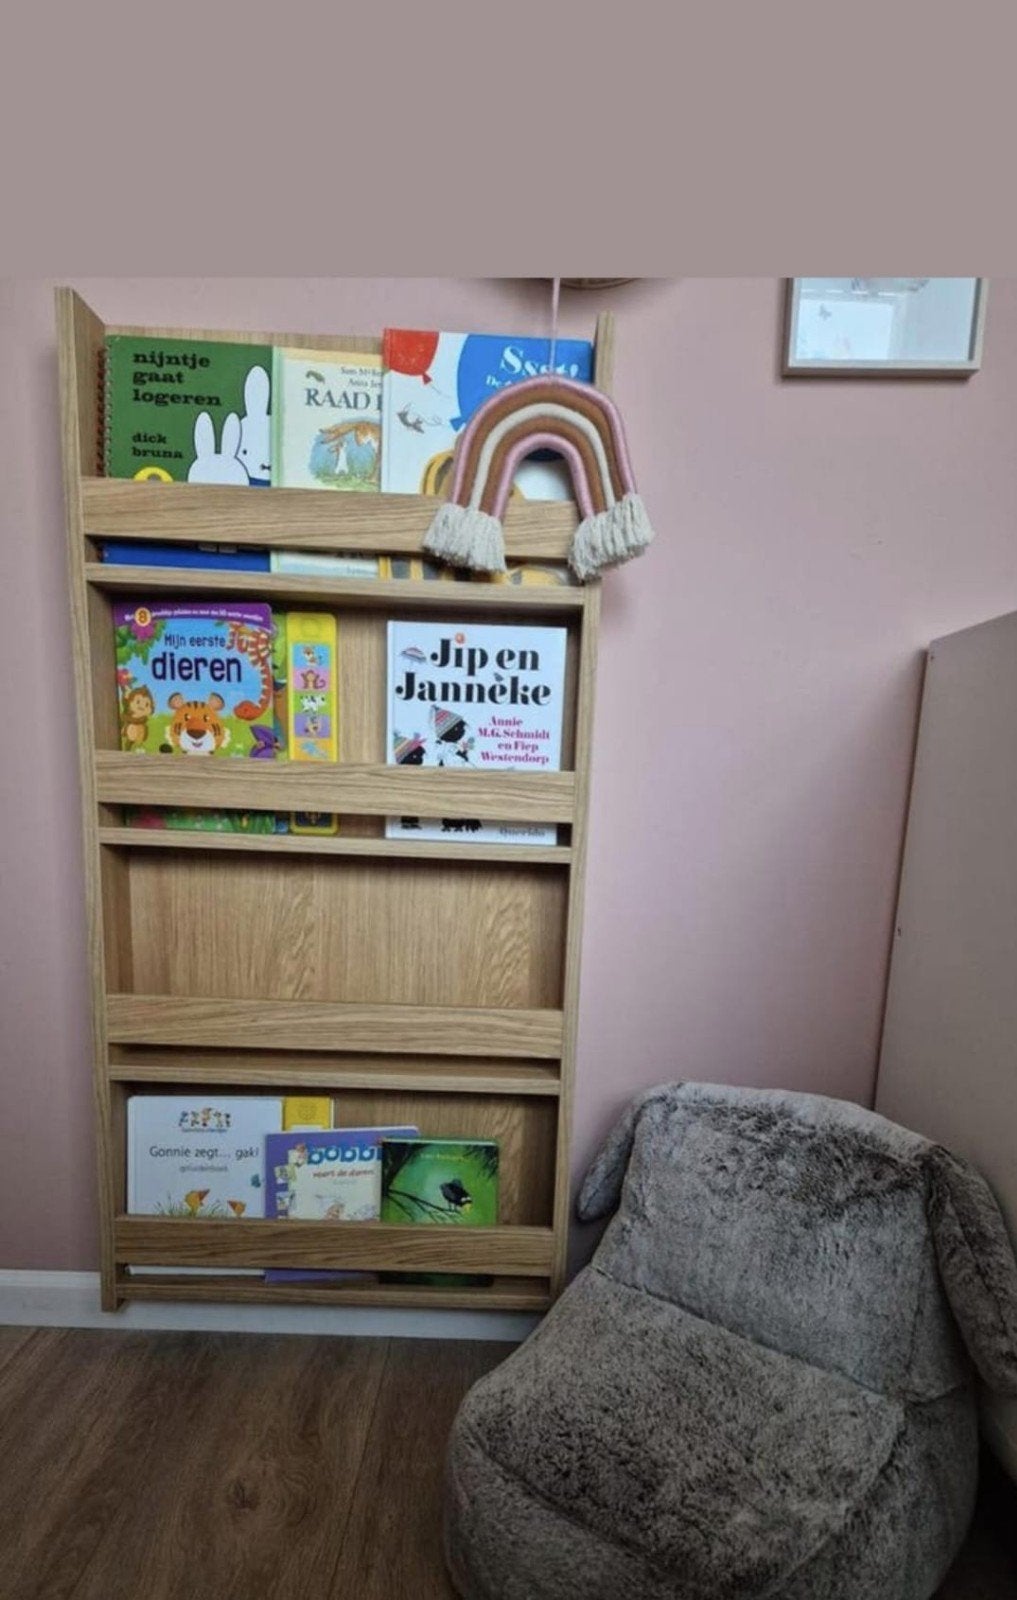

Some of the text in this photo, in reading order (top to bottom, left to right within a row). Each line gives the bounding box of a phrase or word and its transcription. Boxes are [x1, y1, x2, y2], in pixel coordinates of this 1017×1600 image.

[132, 351, 210, 370] nijntje
[132, 369, 185, 386] gaat
[132, 388, 222, 407] logeren
[305, 387, 371, 410] RAAD
[132, 432, 167, 444] dick
[131, 446, 183, 460] bruna
[164, 633, 226, 649] Mijn eerste
[430, 634, 540, 676] Jip en
[151, 653, 242, 682] dieren
[488, 715, 523, 727] Annie
[502, 729, 550, 741] Schmidt
[497, 741, 539, 754] en Fiep
[481, 752, 550, 766] Westendorp
[149, 1145, 191, 1158] Gonnie
[235, 1147, 259, 1160] gak!
